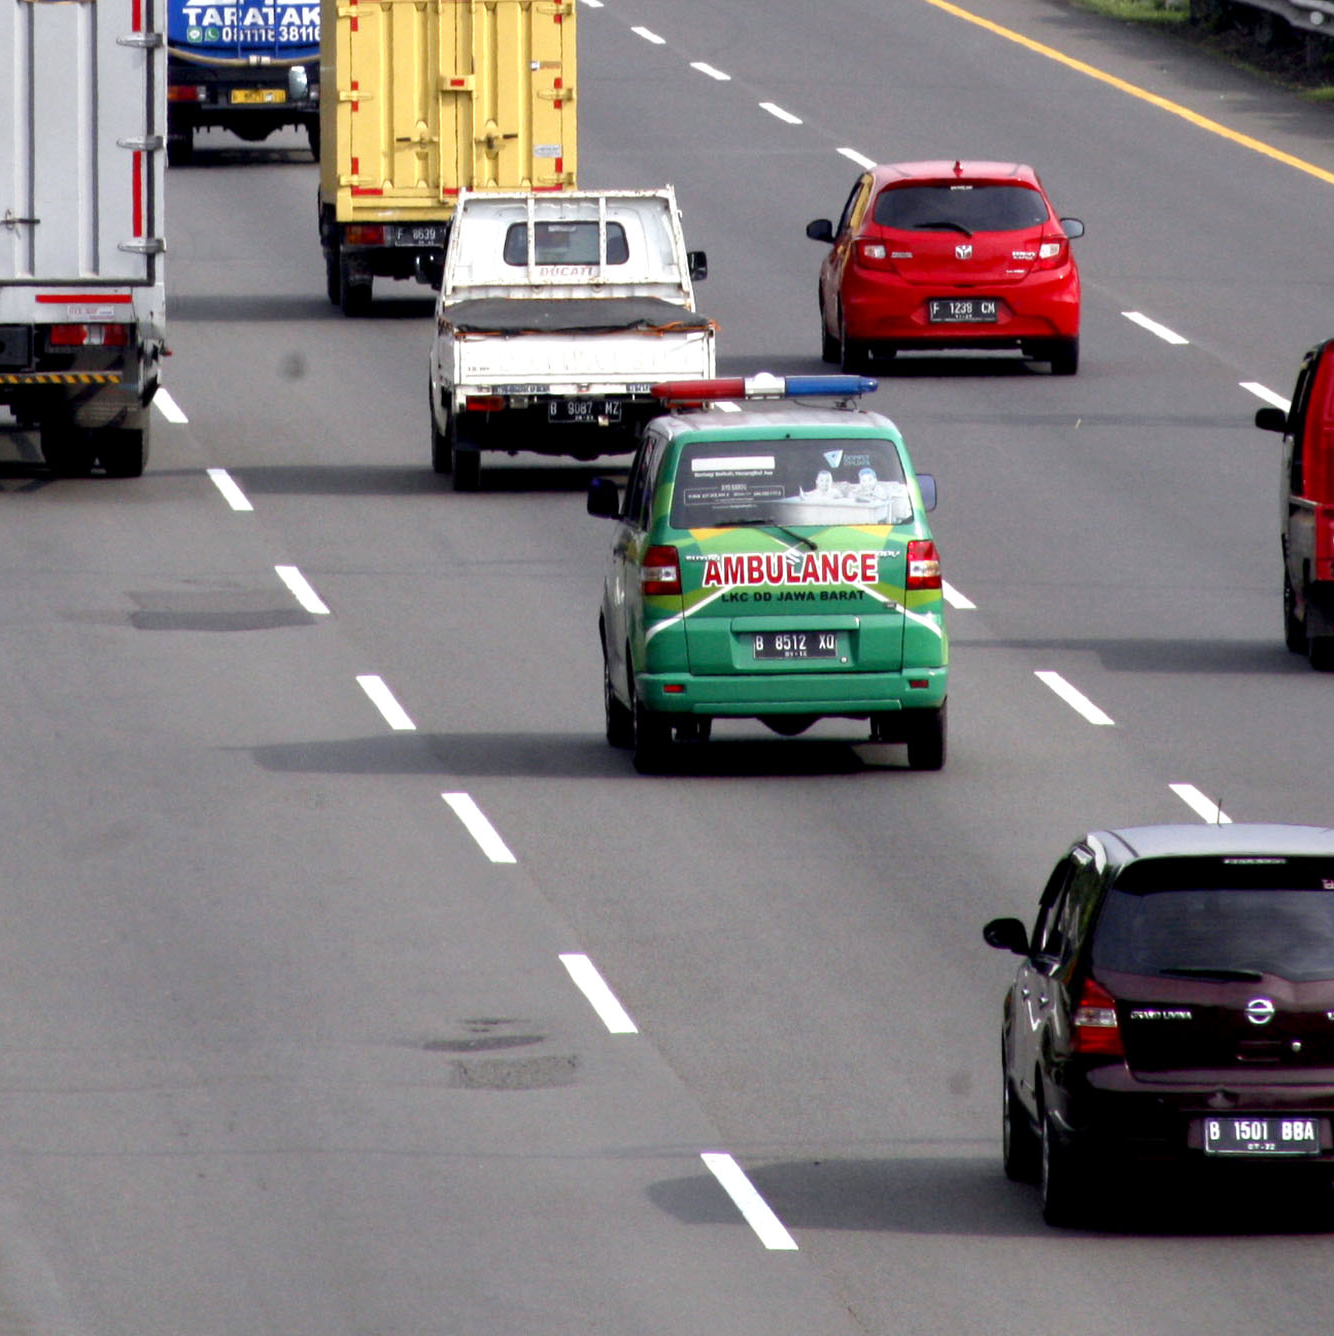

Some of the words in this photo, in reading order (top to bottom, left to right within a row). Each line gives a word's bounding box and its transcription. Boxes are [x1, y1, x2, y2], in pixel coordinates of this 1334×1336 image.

[182, 8, 321, 27] TARATAK
[539, 266, 596, 277] DUCATI
[932, 303, 939, 314] F
[981, 302, 995, 314] CM
[550, 402, 557, 415] B
[568, 402, 593, 415] 9087
[605, 401, 620, 415] MZ
[703, 552, 879, 587] AMBULANCE
[722, 592, 749, 602] LKC
[753, 591, 772, 602] DD
[777, 591, 815, 602] JAWA
[820, 590, 865, 601] BARAT
[755, 637, 764, 651] B
[775, 635, 807, 650] 8512
[1209, 1123, 1220, 1140] B
[1234, 1122, 1268, 1141] 1501
[1281, 1122, 1315, 1141] BBA
